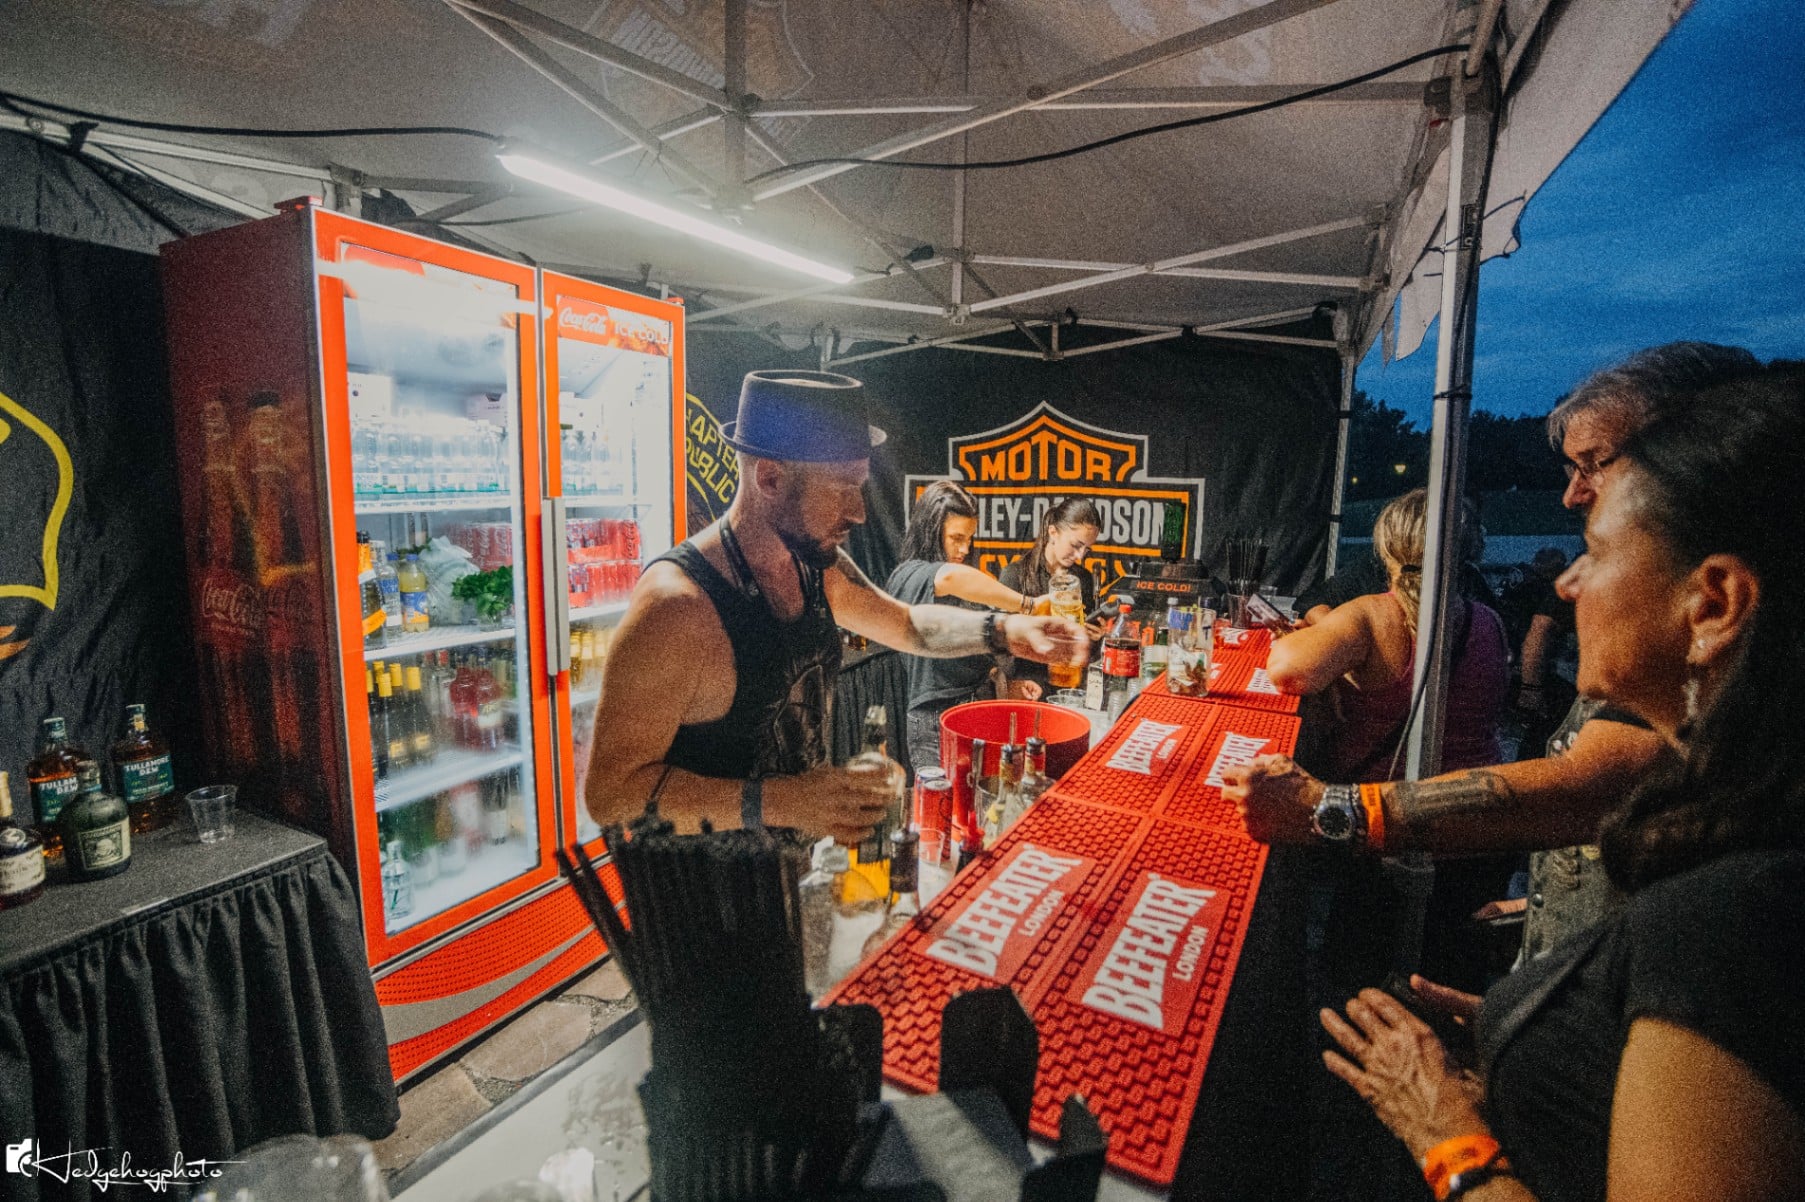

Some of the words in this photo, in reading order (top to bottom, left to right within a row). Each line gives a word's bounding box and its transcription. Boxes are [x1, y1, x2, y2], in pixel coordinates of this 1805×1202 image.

[559, 307, 608, 336] Coca-Cola
[981, 430, 1111, 482] MOTOR
[1136, 581, 1155, 591] ICE
[1158, 582, 1192, 593] COLD!
[123, 755, 170, 772] TULLAMORE
[139, 765, 159, 776] DEW
[56, 783, 79, 795] DEW
[925, 845, 1084, 977] BEEFEATER
[1017, 889, 1065, 938] LONDON
[1081, 874, 1218, 1030] BEEFEATER
[1172, 925, 1211, 982] LONDON
